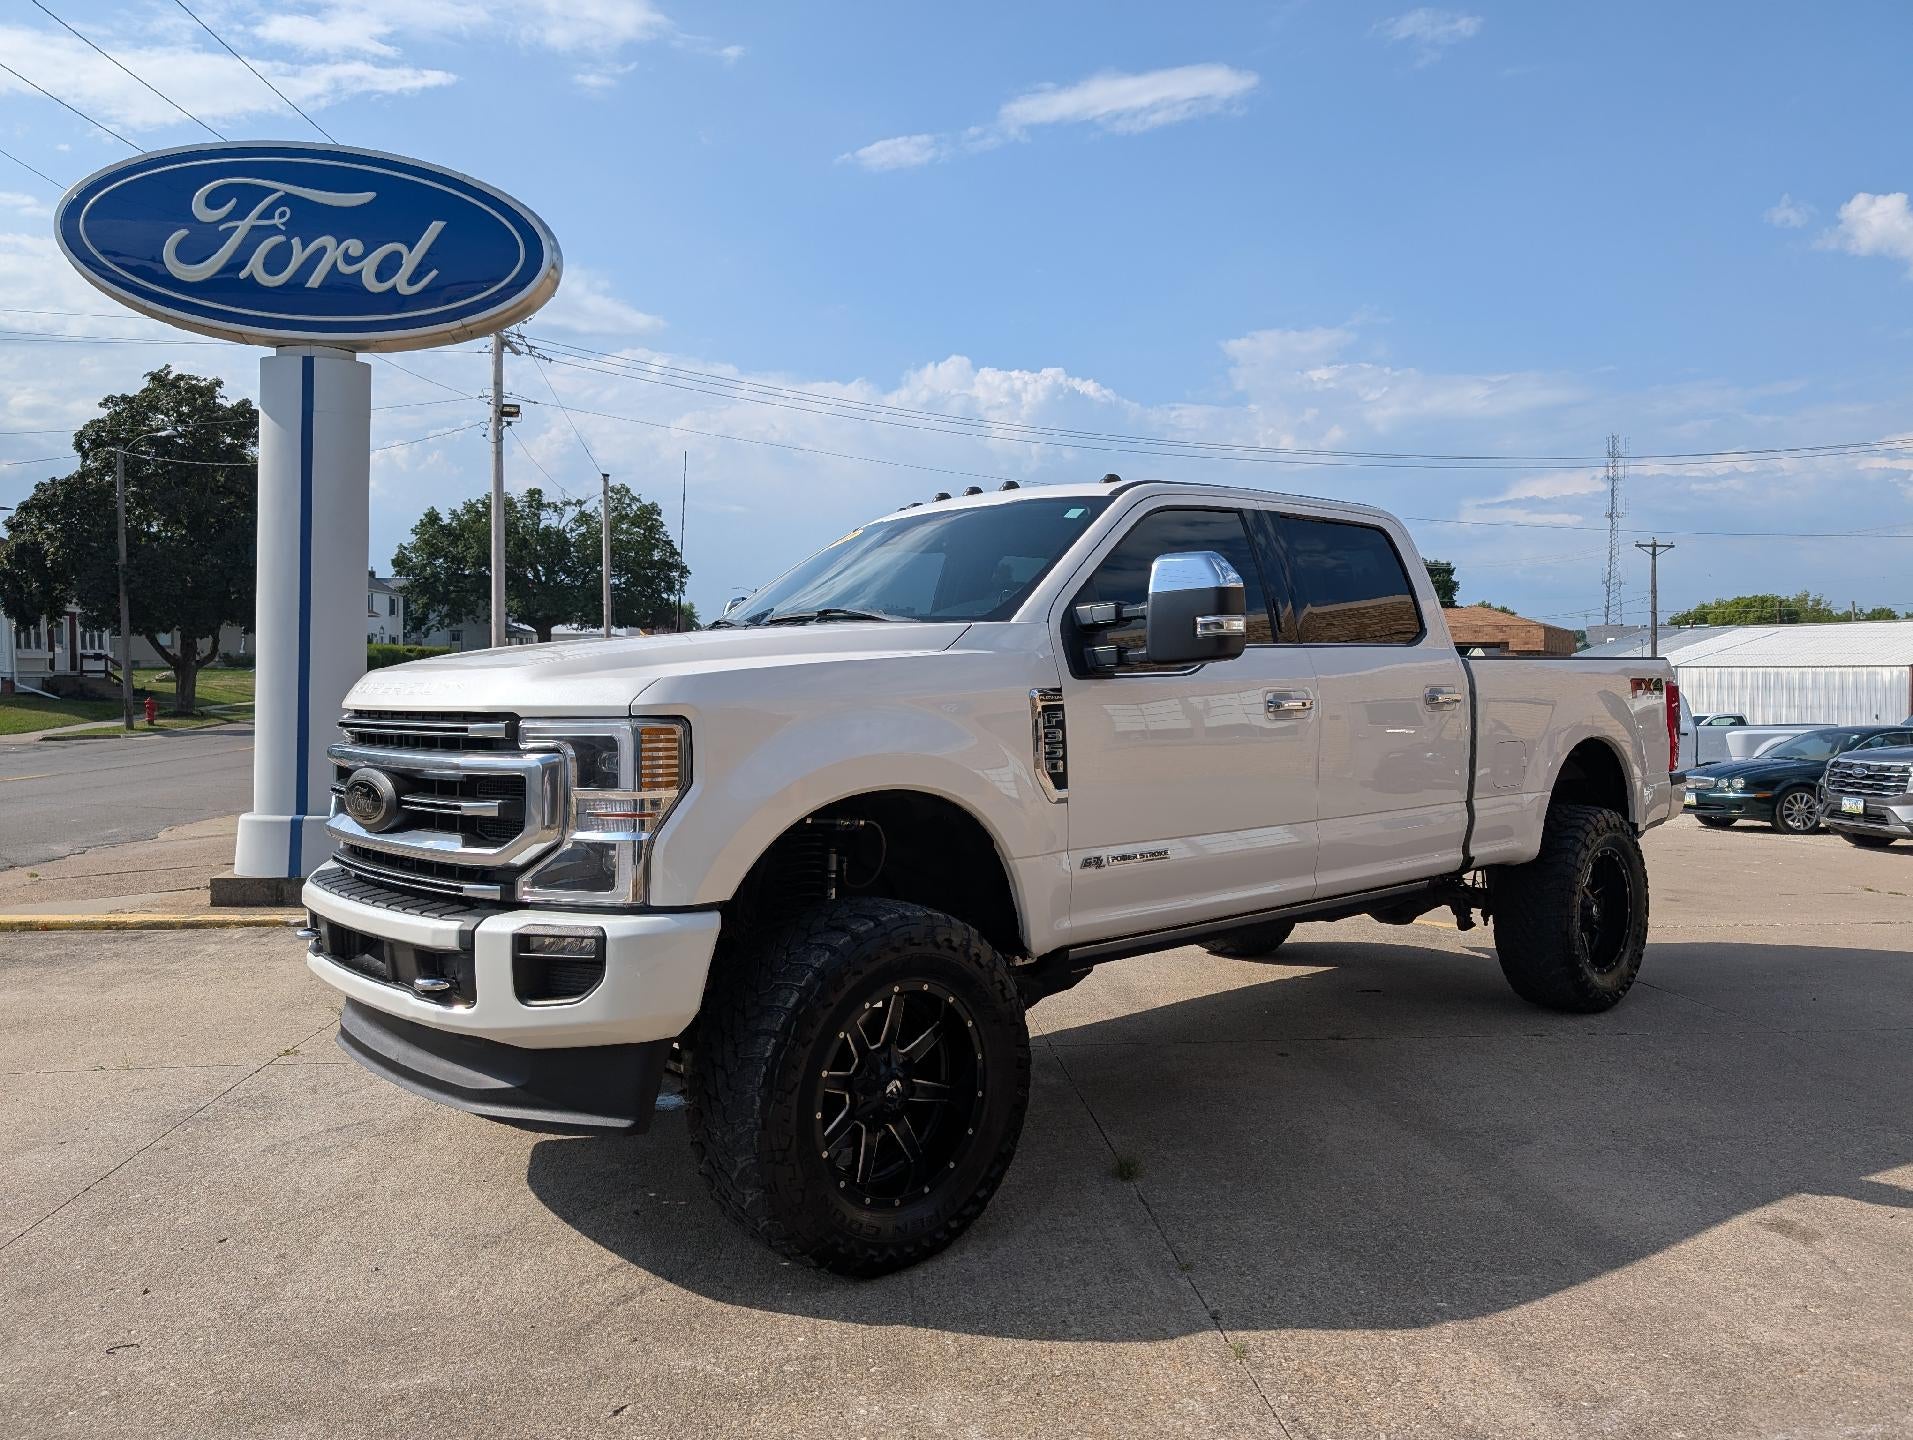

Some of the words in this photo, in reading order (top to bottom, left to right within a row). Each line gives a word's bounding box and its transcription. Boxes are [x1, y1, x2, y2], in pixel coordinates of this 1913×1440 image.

[162, 176, 446, 295] Ford
[1630, 678, 1664, 699] FX4
[350, 785, 374, 813] Ford
[1110, 854, 1138, 863] POWER
[1139, 850, 1169, 860] STROKE
